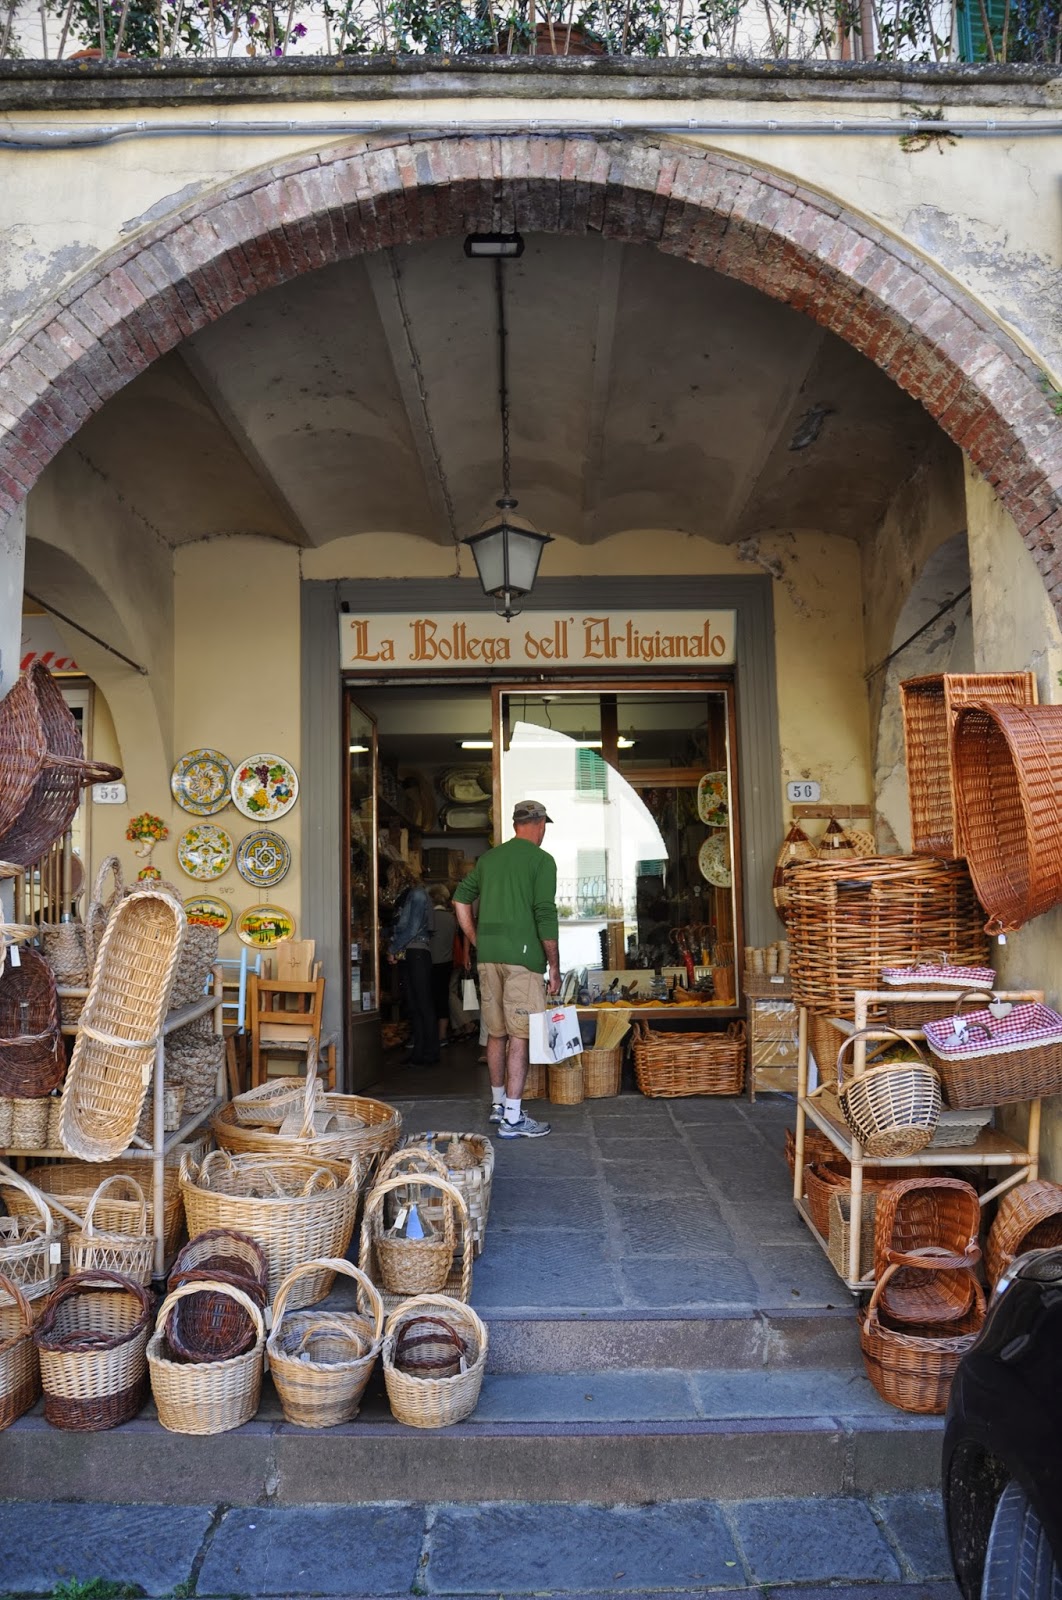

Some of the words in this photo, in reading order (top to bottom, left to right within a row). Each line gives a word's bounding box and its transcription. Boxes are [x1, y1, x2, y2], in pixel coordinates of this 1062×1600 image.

[350, 620, 395, 662] La
[408, 618, 511, 665] Bottega
[524, 617, 574, 660] dell'
[582, 617, 726, 662] Artigianato
[100, 786, 119, 800] 55
[793, 785, 812, 798] 56
